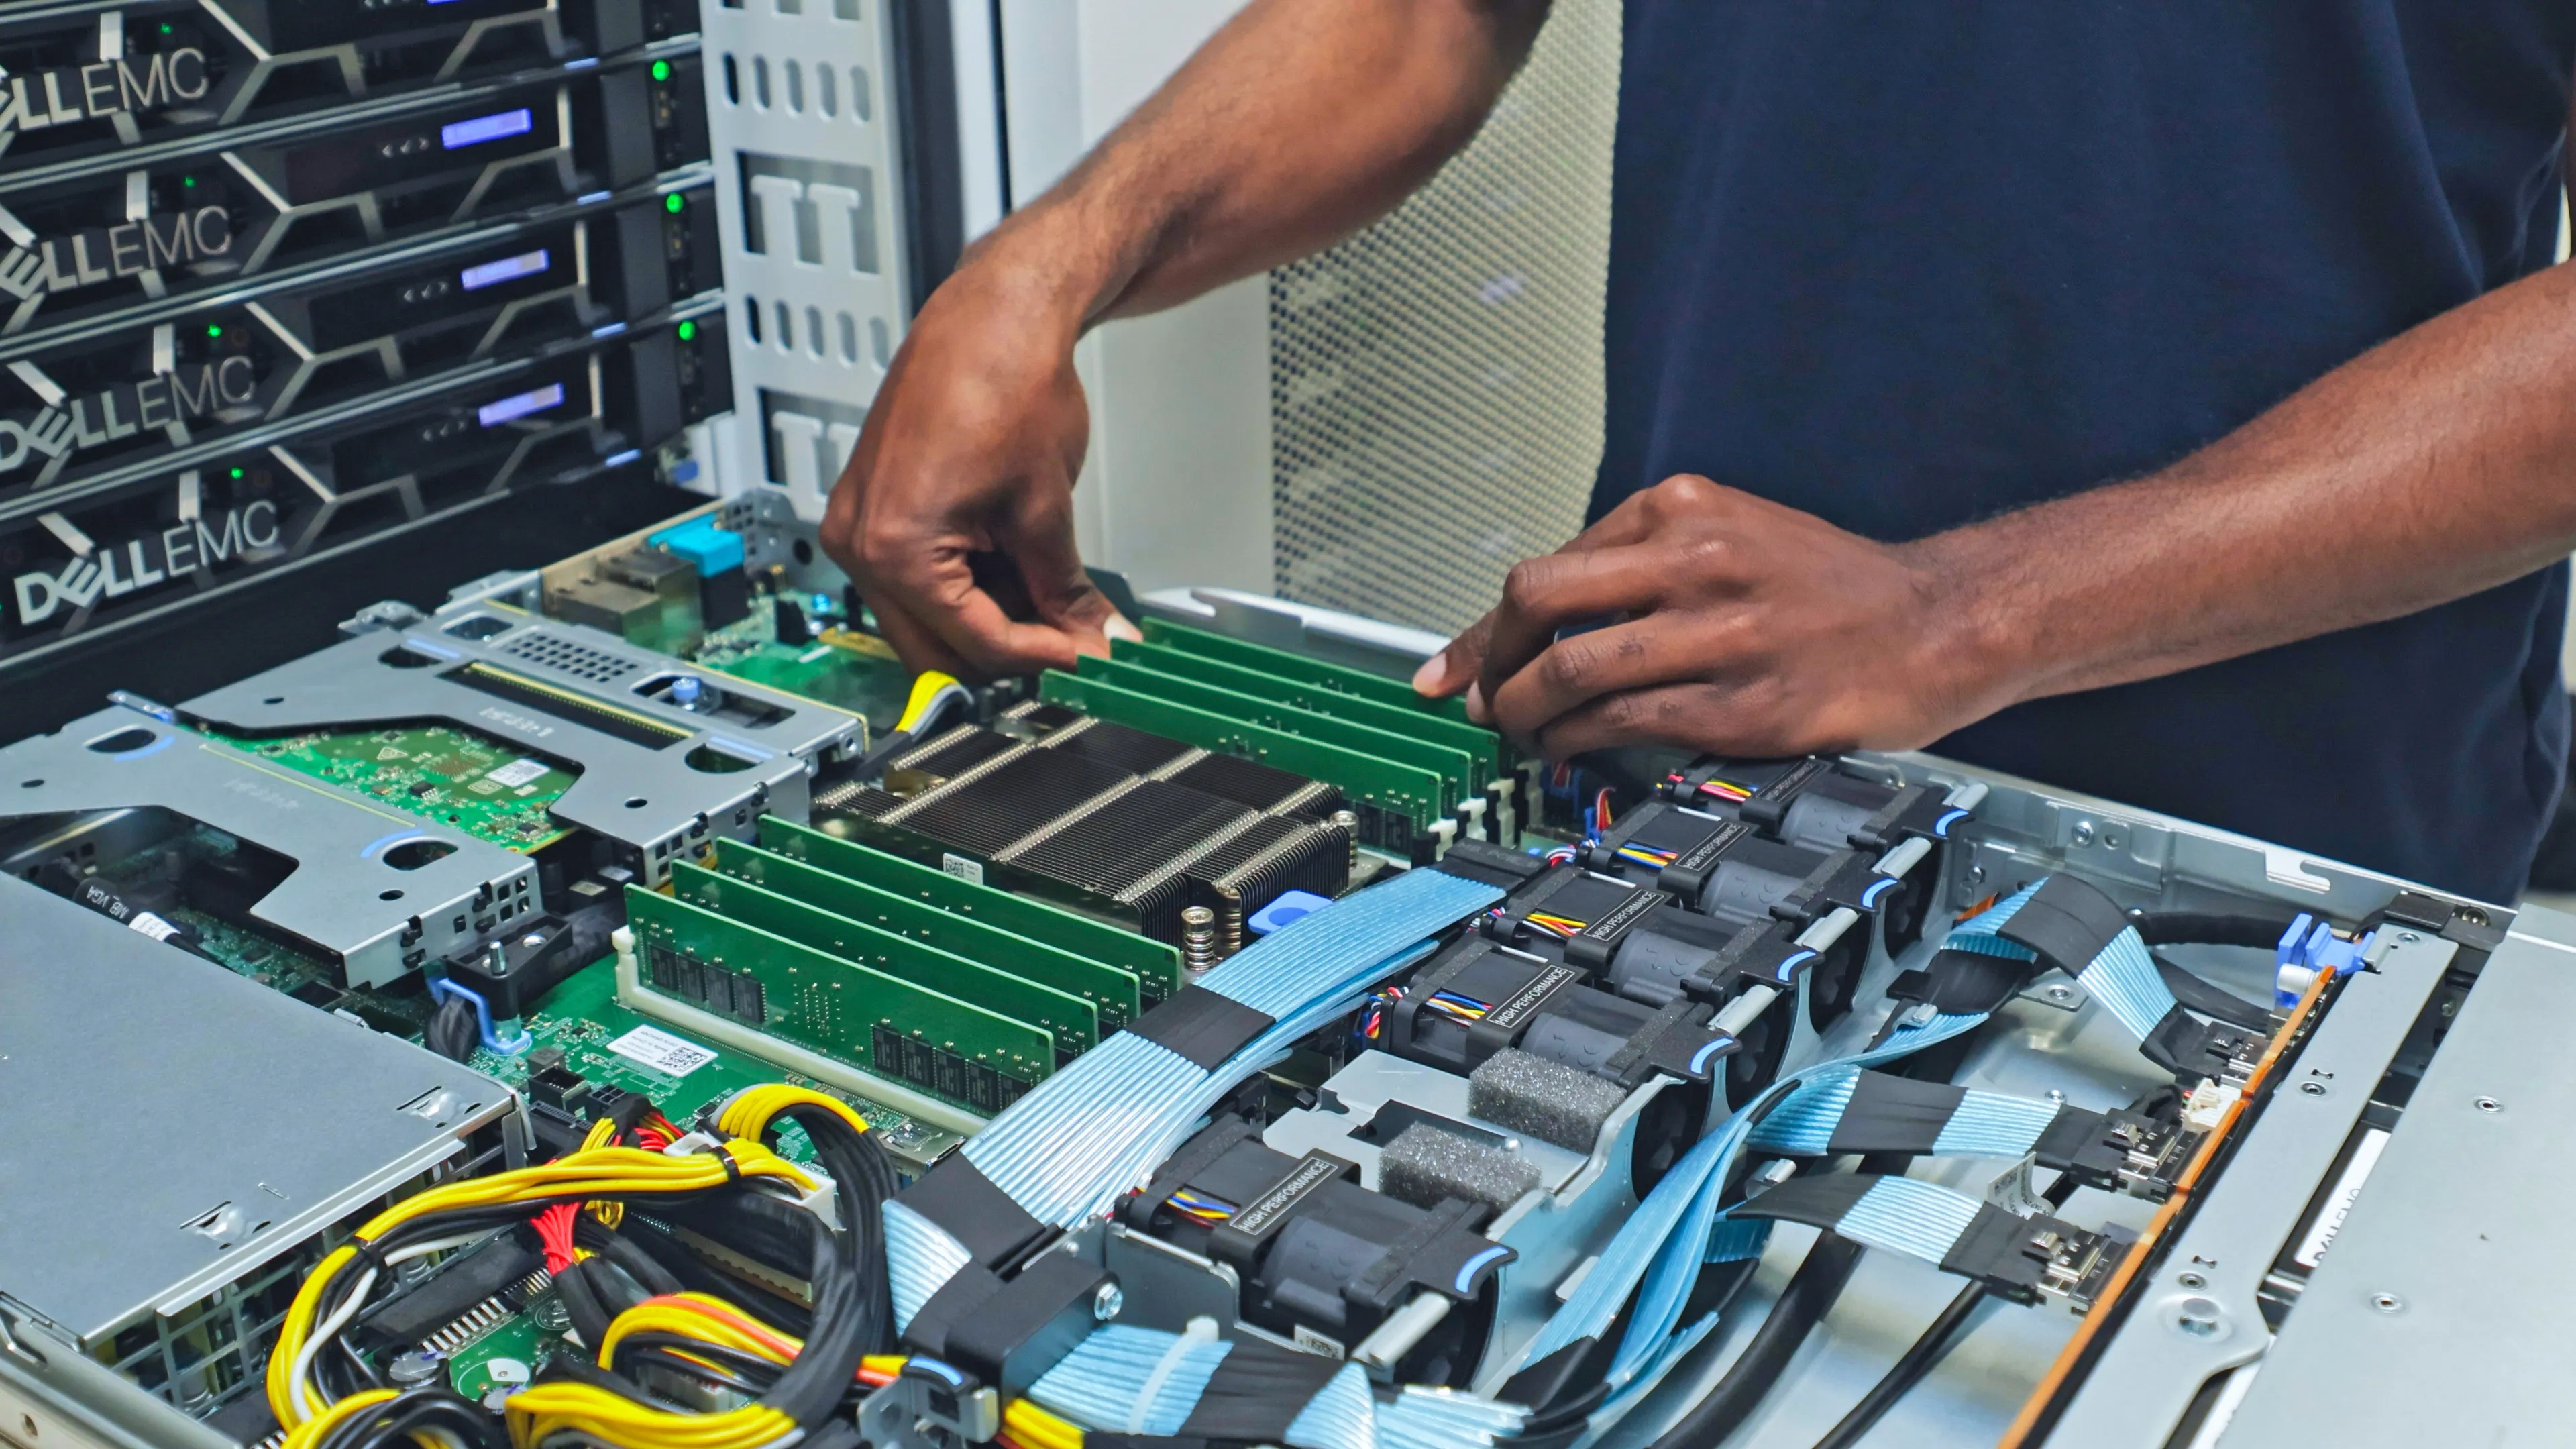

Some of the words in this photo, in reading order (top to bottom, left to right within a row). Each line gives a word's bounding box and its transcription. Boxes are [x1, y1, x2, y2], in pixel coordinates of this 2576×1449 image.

[1591, 924, 1614, 939] HIGH
[1607, 892, 1656, 926] PERFORMANCE
[1495, 1008, 1519, 1025] HIGH
[1512, 968, 1566, 1010] PERFORMANCE
[1238, 1210, 1269, 1231] HIGH
[1260, 1161, 1330, 1213] PERFORMANCE
